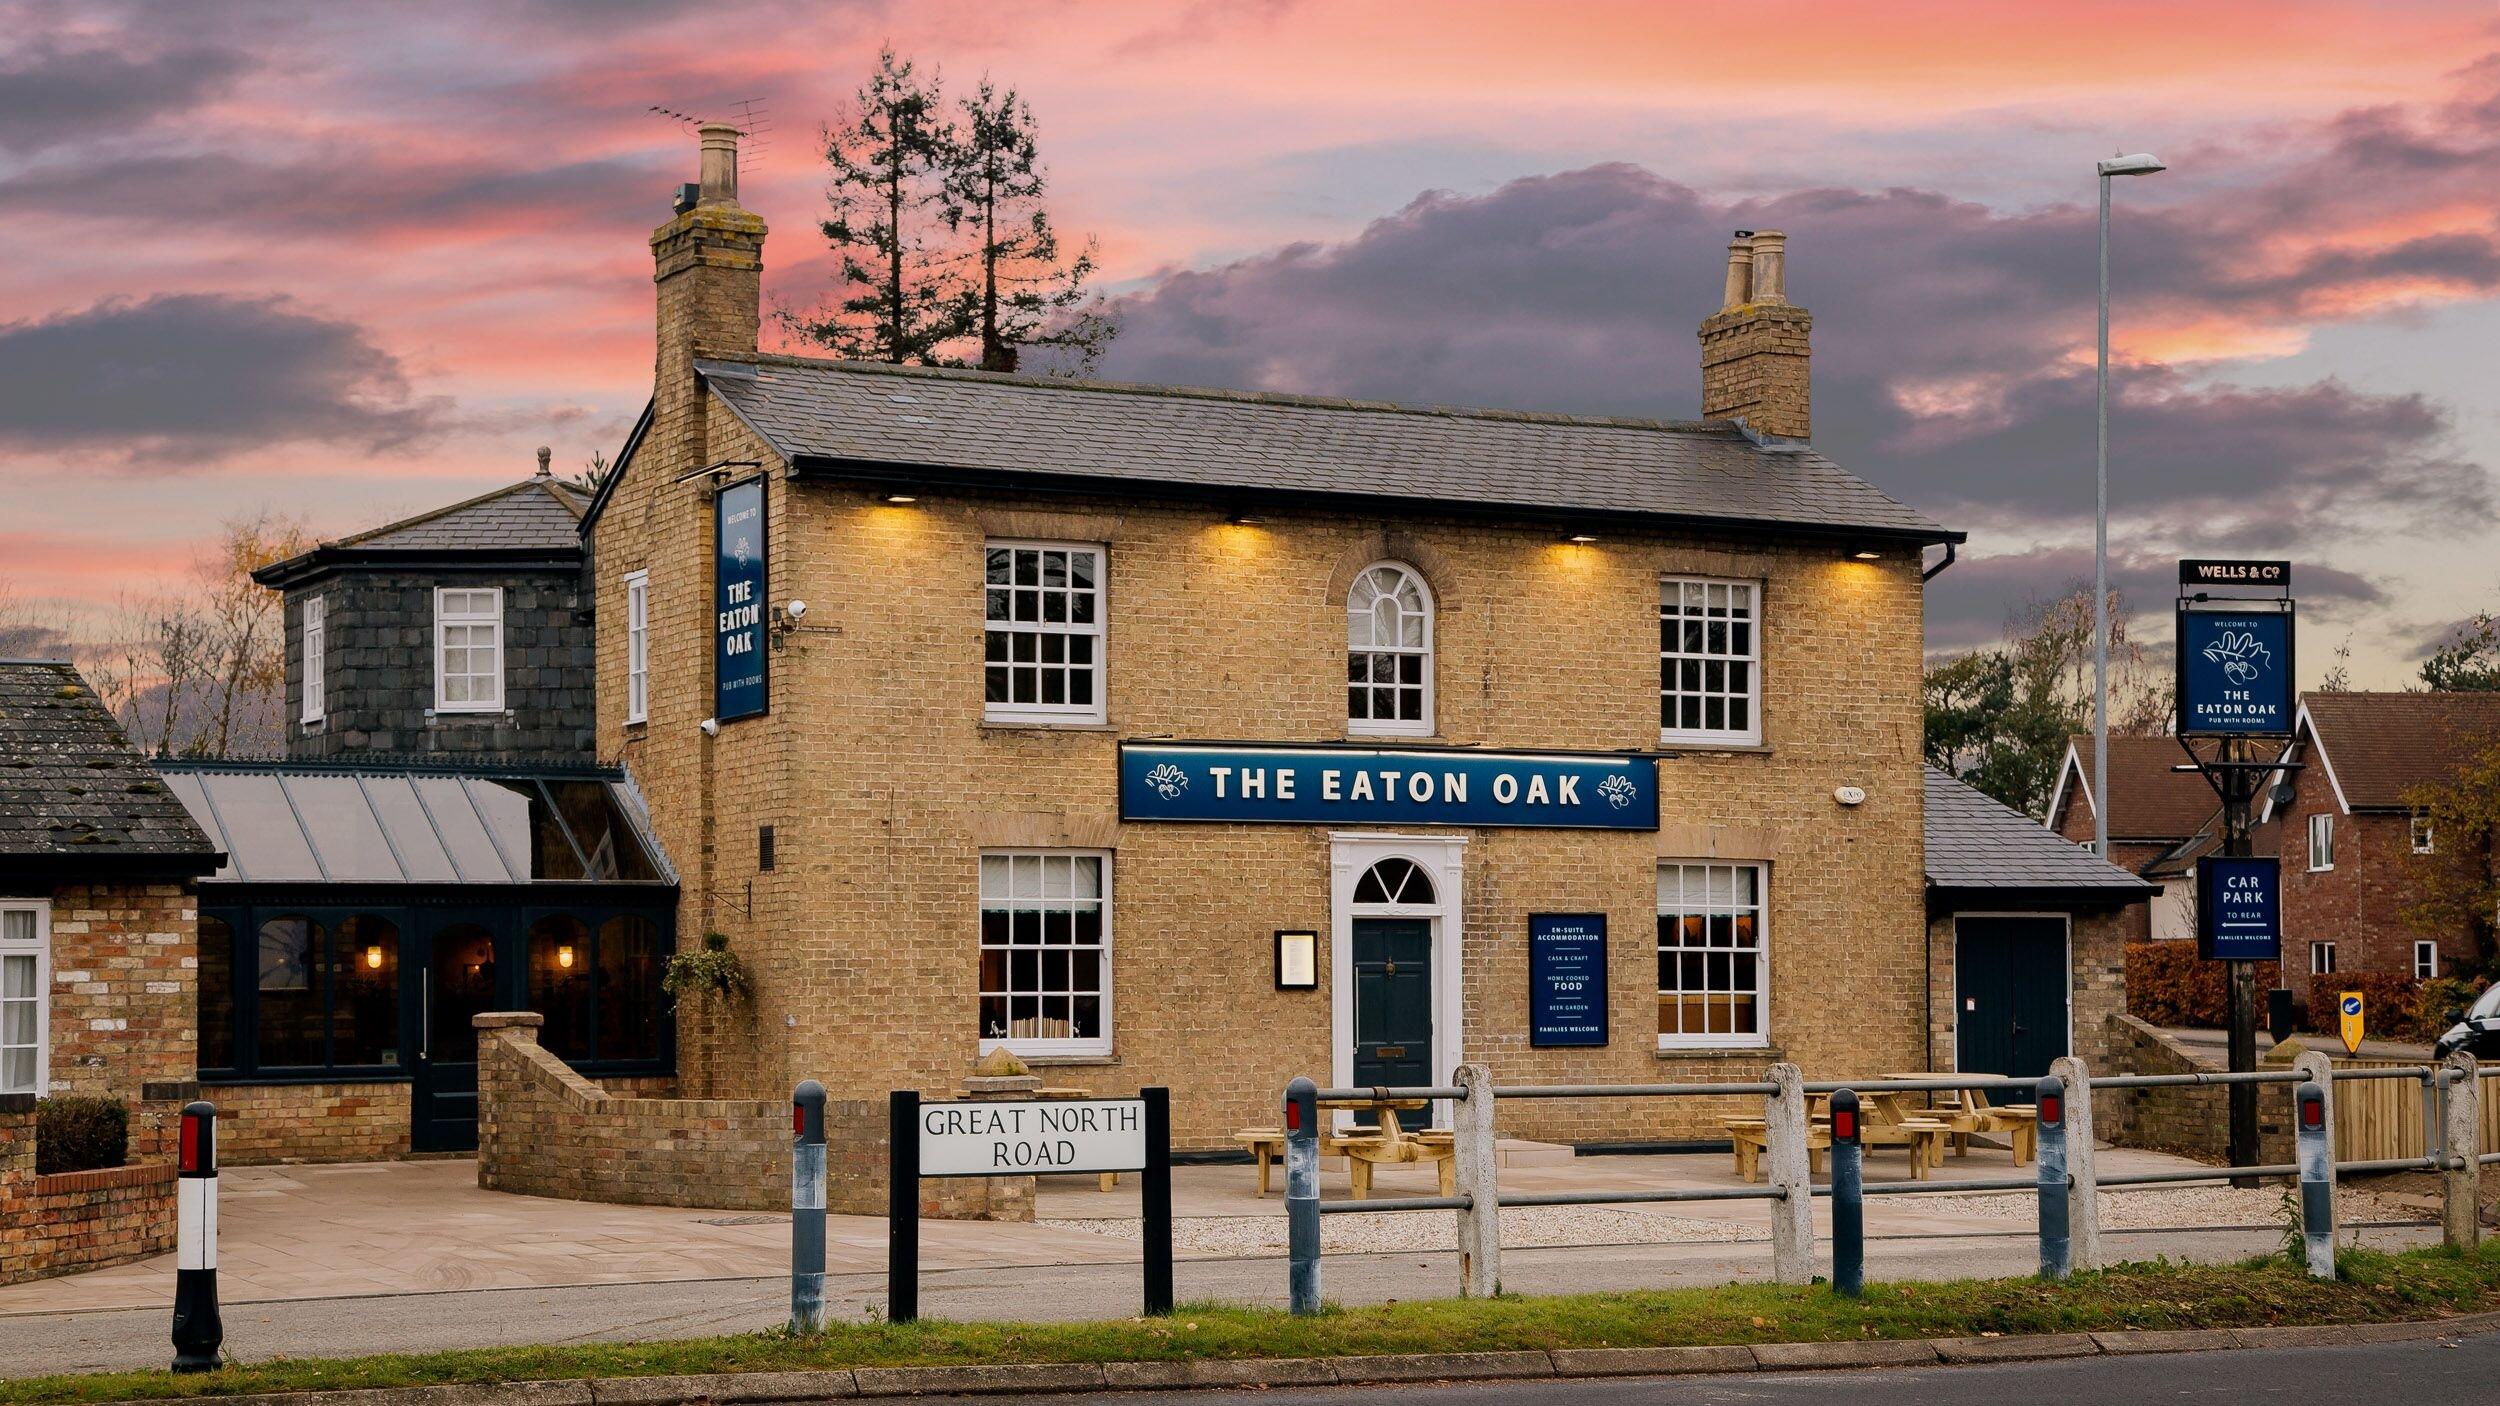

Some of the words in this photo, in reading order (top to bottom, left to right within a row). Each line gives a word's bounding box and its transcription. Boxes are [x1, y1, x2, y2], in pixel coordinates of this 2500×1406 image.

[727, 509, 750, 525] WELCOME
[750, 507, 757, 517] TO
[2198, 565, 2246, 578] WELLS
[2249, 566, 2260, 579] &
[727, 580, 752, 605] THE
[719, 603, 760, 633] EATON
[726, 631, 753, 656] OAK
[722, 681, 732, 691] PUB
[733, 679, 745, 689] WITH
[745, 674, 762, 686] ROOMS
[2224, 690, 2250, 700] THE
[2197, 704, 2242, 714] EATON
[2248, 704, 2276, 714] OAK
[1209, 767, 1296, 800] THE
[1322, 769, 1468, 803] EATON
[1492, 773, 1581, 805] OAK
[2227, 876, 2259, 888] CAR
[2223, 892, 2264, 903] PARK
[1554, 982, 1583, 990] FOOD
[925, 1108, 1026, 1136] GREAT
[1039, 1106, 1138, 1133] NORTH
[993, 1140, 1076, 1167] ROAD
